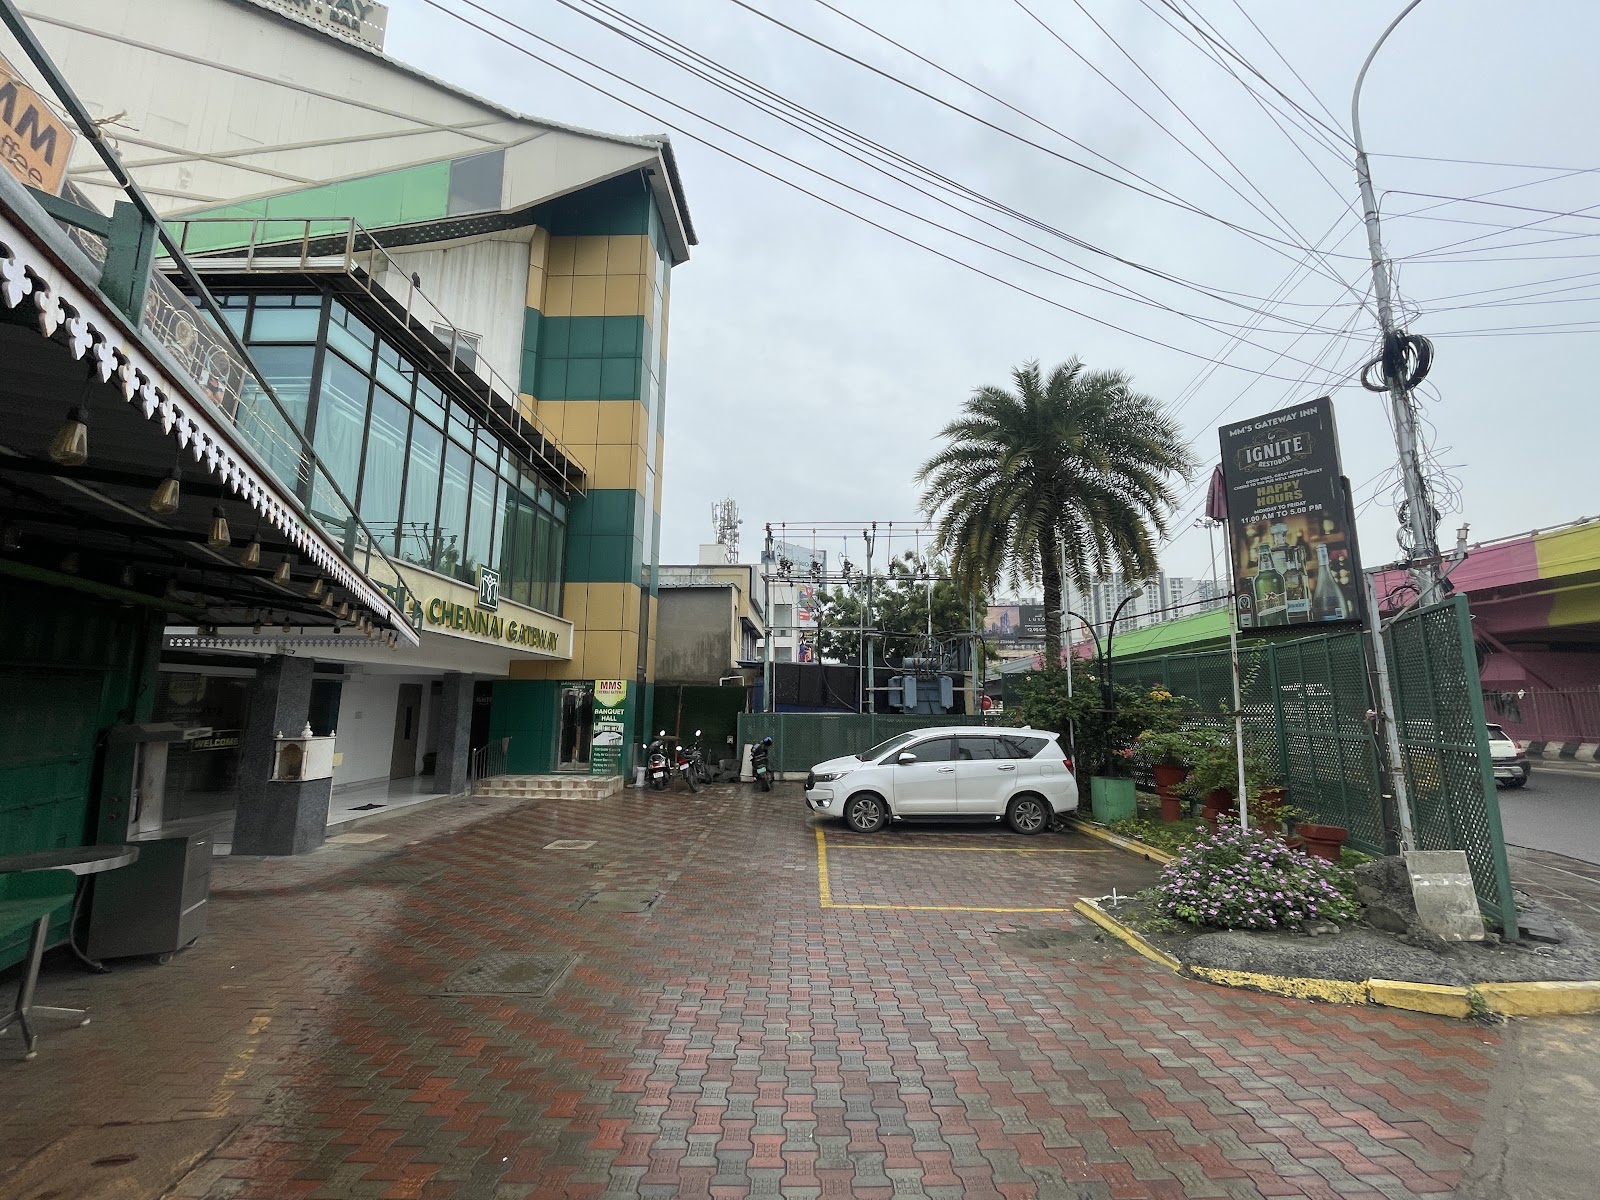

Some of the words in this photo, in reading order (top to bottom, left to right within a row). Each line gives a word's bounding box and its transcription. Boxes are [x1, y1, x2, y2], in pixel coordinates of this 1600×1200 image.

[330, 9, 360, 33] BAR
[1230, 425, 1252, 437] MM'S
[1254, 412, 1298, 430] GATEWAY
[1300, 406, 1318, 418] INN
[1246, 436, 1303, 463] IGNITE
[1258, 455, 1292, 467] RESTOBAR
[1256, 480, 1300, 496] HAPPY
[1256, 490, 1303, 506] HOURS
[1287, 500, 1306, 508] FRIDAY
[425, 598, 504, 639] CHENNAI
[505, 620, 559, 652] GATEWAY
[601, 681, 622, 690] MMS
[194, 738, 239, 748] WELCOME
